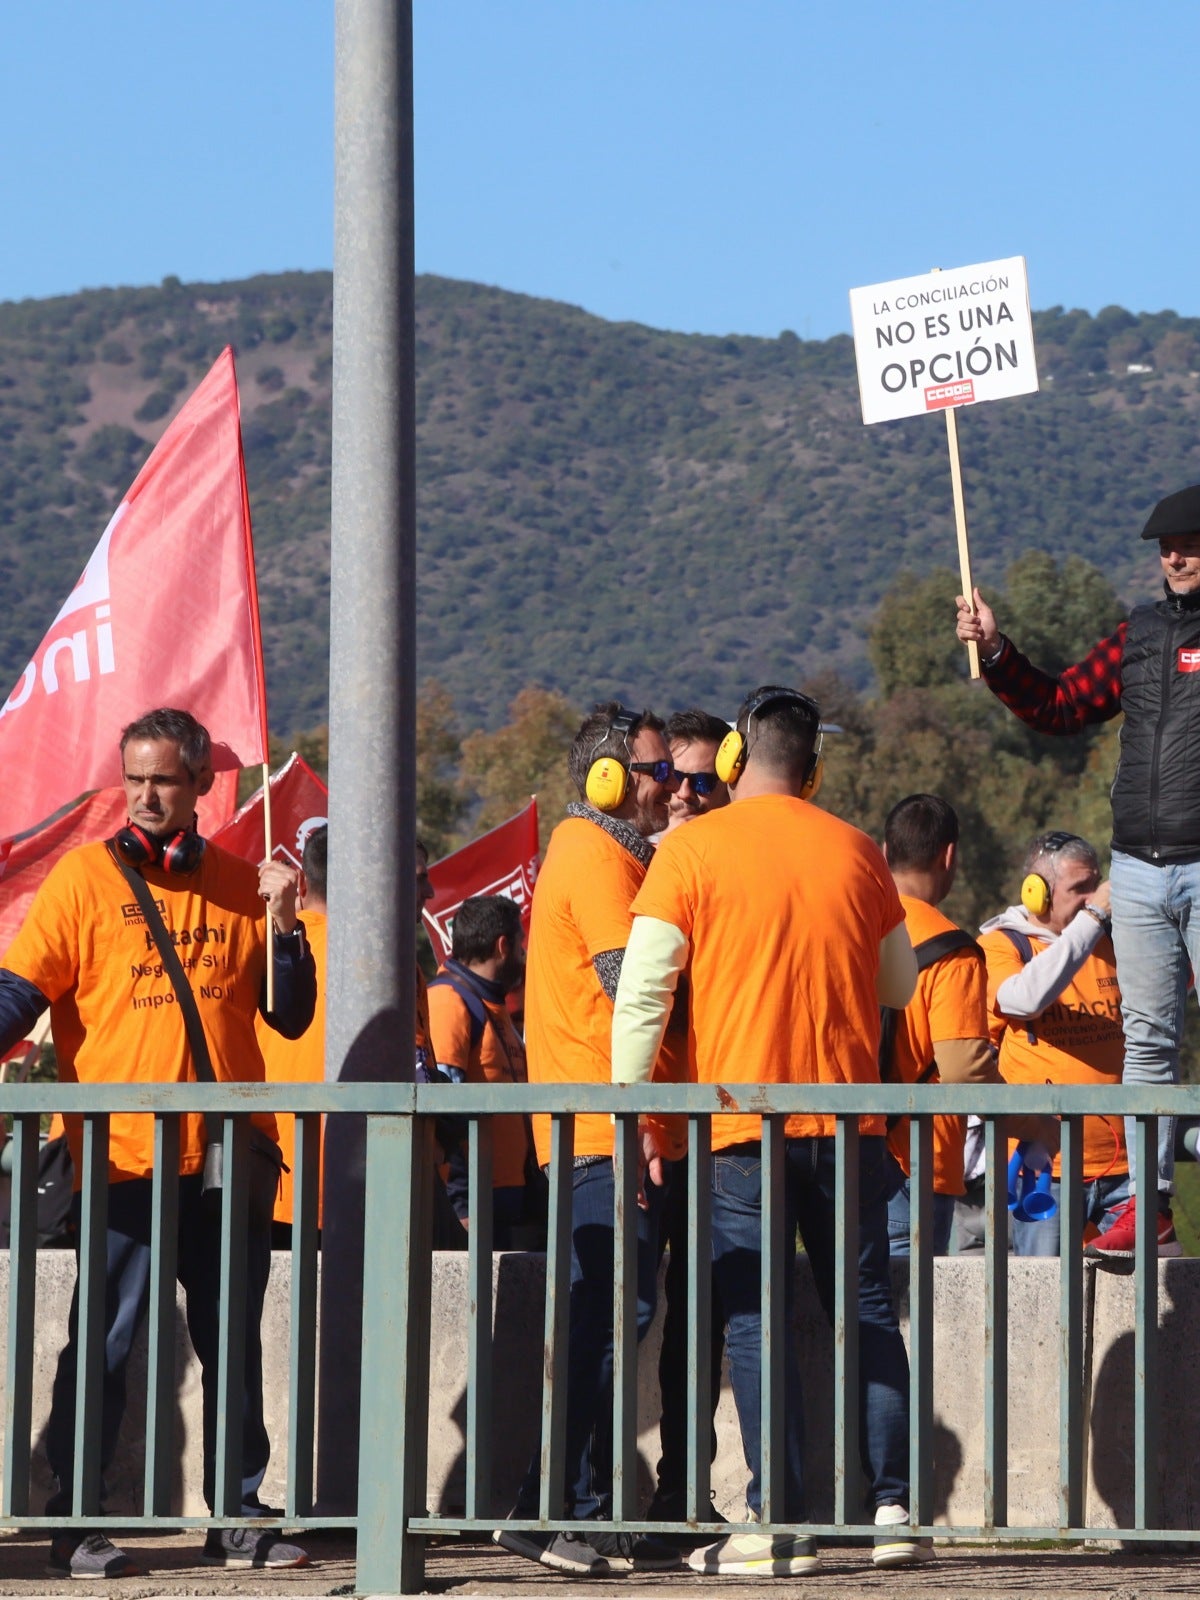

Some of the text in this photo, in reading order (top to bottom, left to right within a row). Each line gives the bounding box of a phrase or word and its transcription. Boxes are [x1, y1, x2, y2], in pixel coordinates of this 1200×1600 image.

[873, 275, 1009, 315] LA CONCILIACIÓN
[876, 301, 1014, 348] NO ES UNA
[880, 336, 1018, 393] OPCIÓN
[145, 924, 226, 951] Htachi
[200, 985, 223, 1000] NO
[1041, 998, 1121, 1023] HITACH
